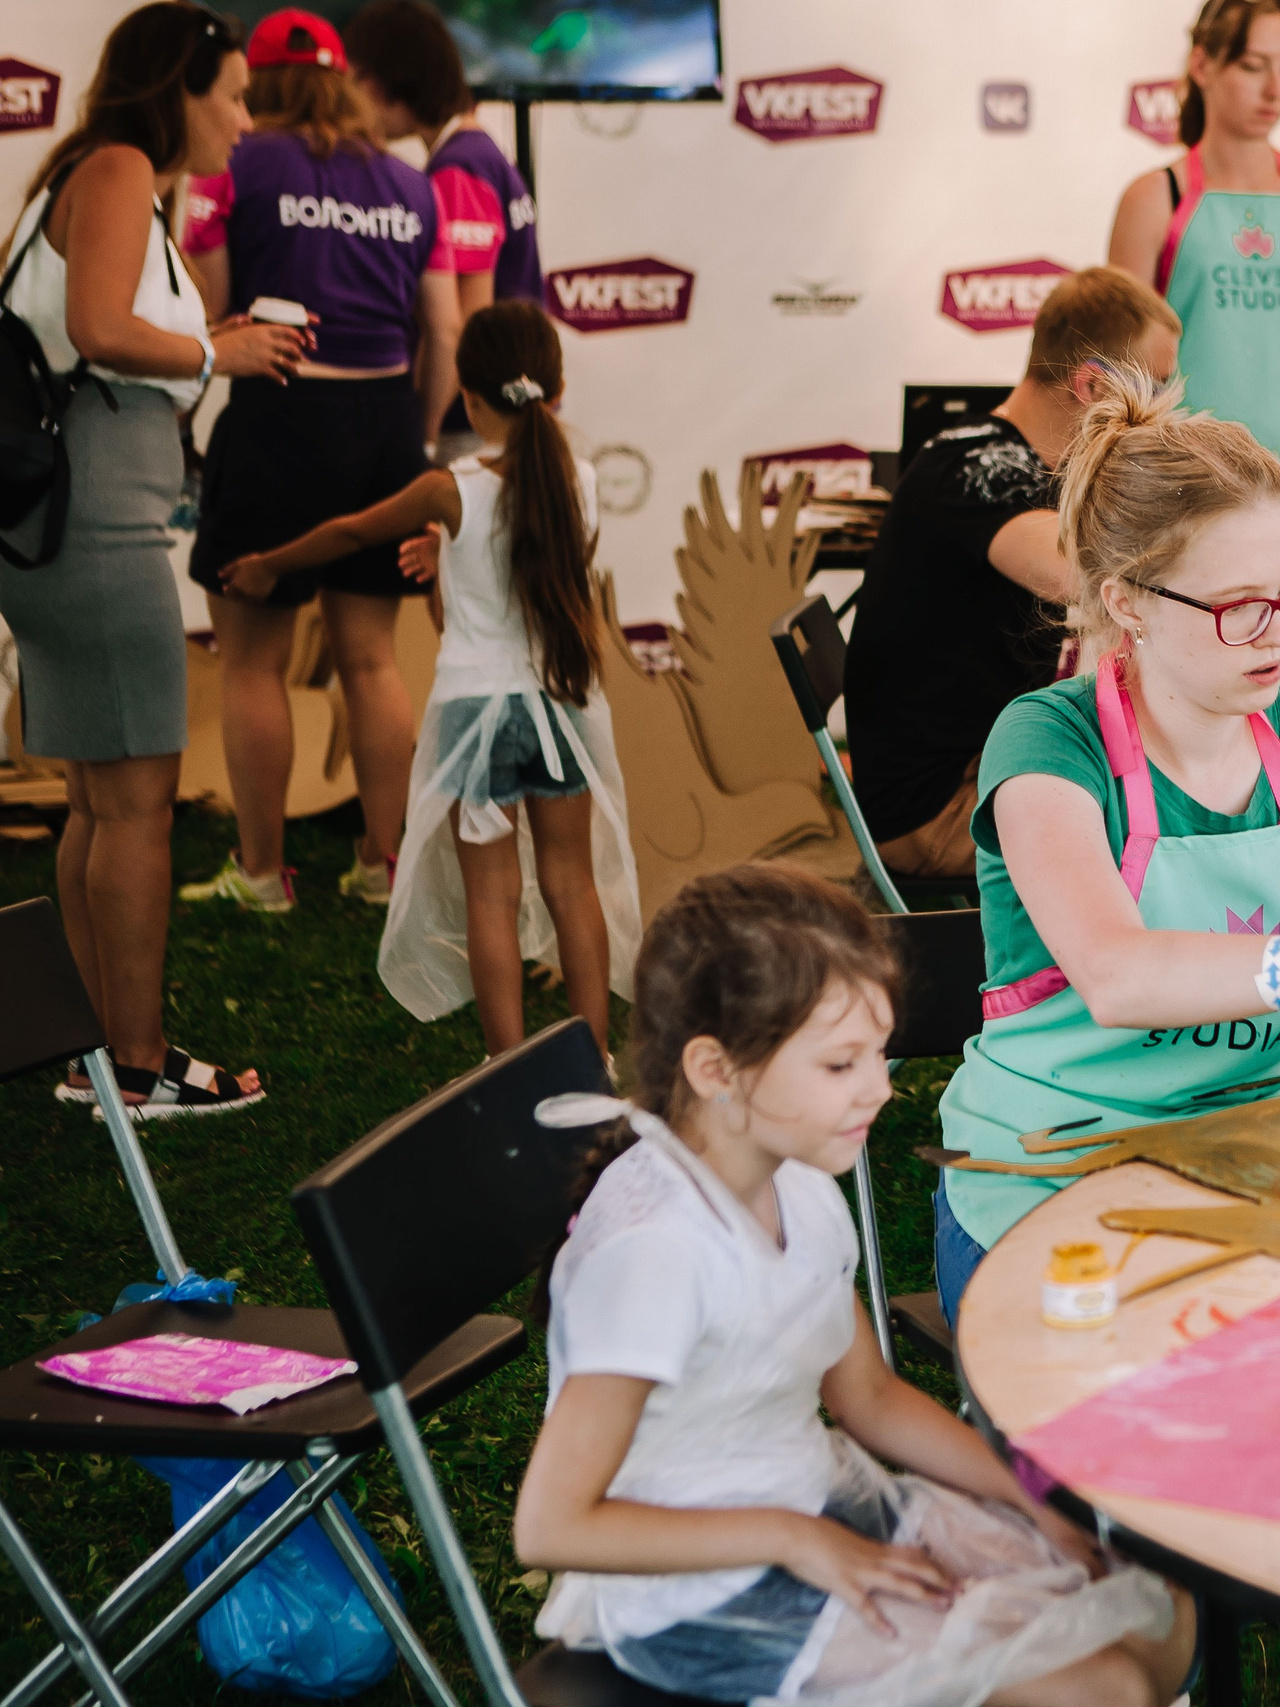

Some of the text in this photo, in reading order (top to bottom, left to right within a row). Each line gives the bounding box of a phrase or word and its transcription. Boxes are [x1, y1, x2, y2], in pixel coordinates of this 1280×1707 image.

[0, 77, 51, 115] ST
[743, 81, 879, 121] VKFEST
[553, 273, 686, 312] VKFEST
